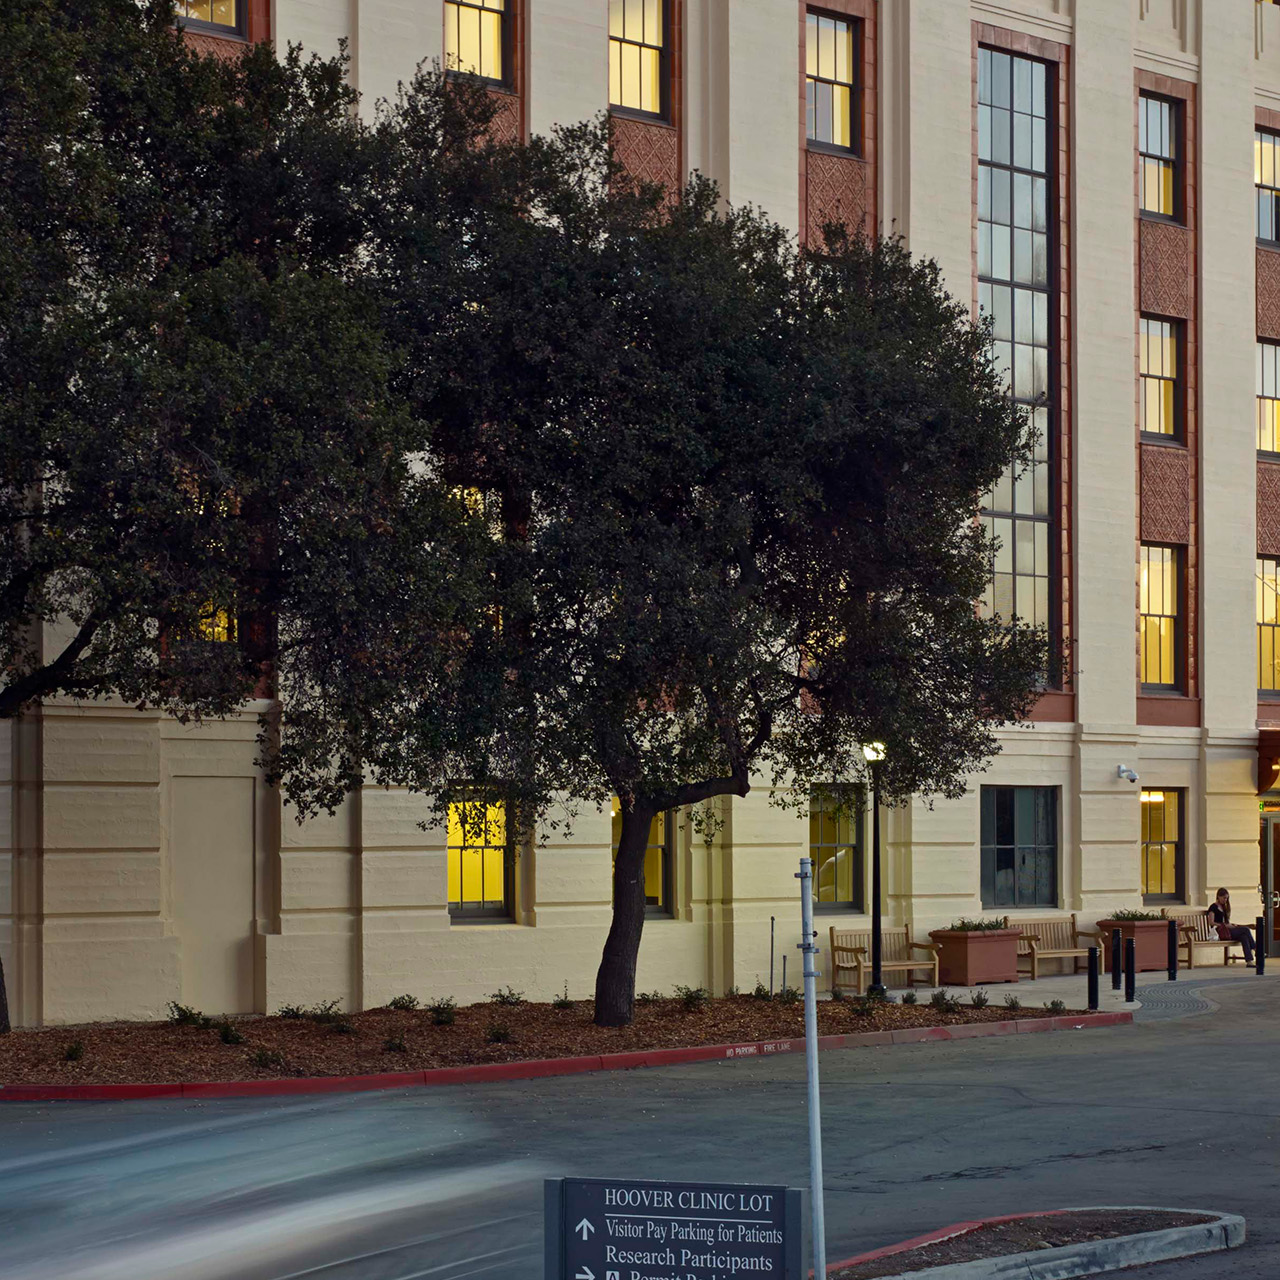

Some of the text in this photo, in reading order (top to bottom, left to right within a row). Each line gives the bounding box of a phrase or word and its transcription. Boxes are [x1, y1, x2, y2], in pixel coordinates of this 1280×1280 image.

[735, 1045, 757, 1055] PARKING
[763, 1043, 776, 1053] FIRE
[604, 1188, 773, 1212] HOOVER CLINIC LOT
[605, 1219, 783, 1246] Visitor Pay Parking for Patients
[605, 1245, 773, 1274] Research Participants
